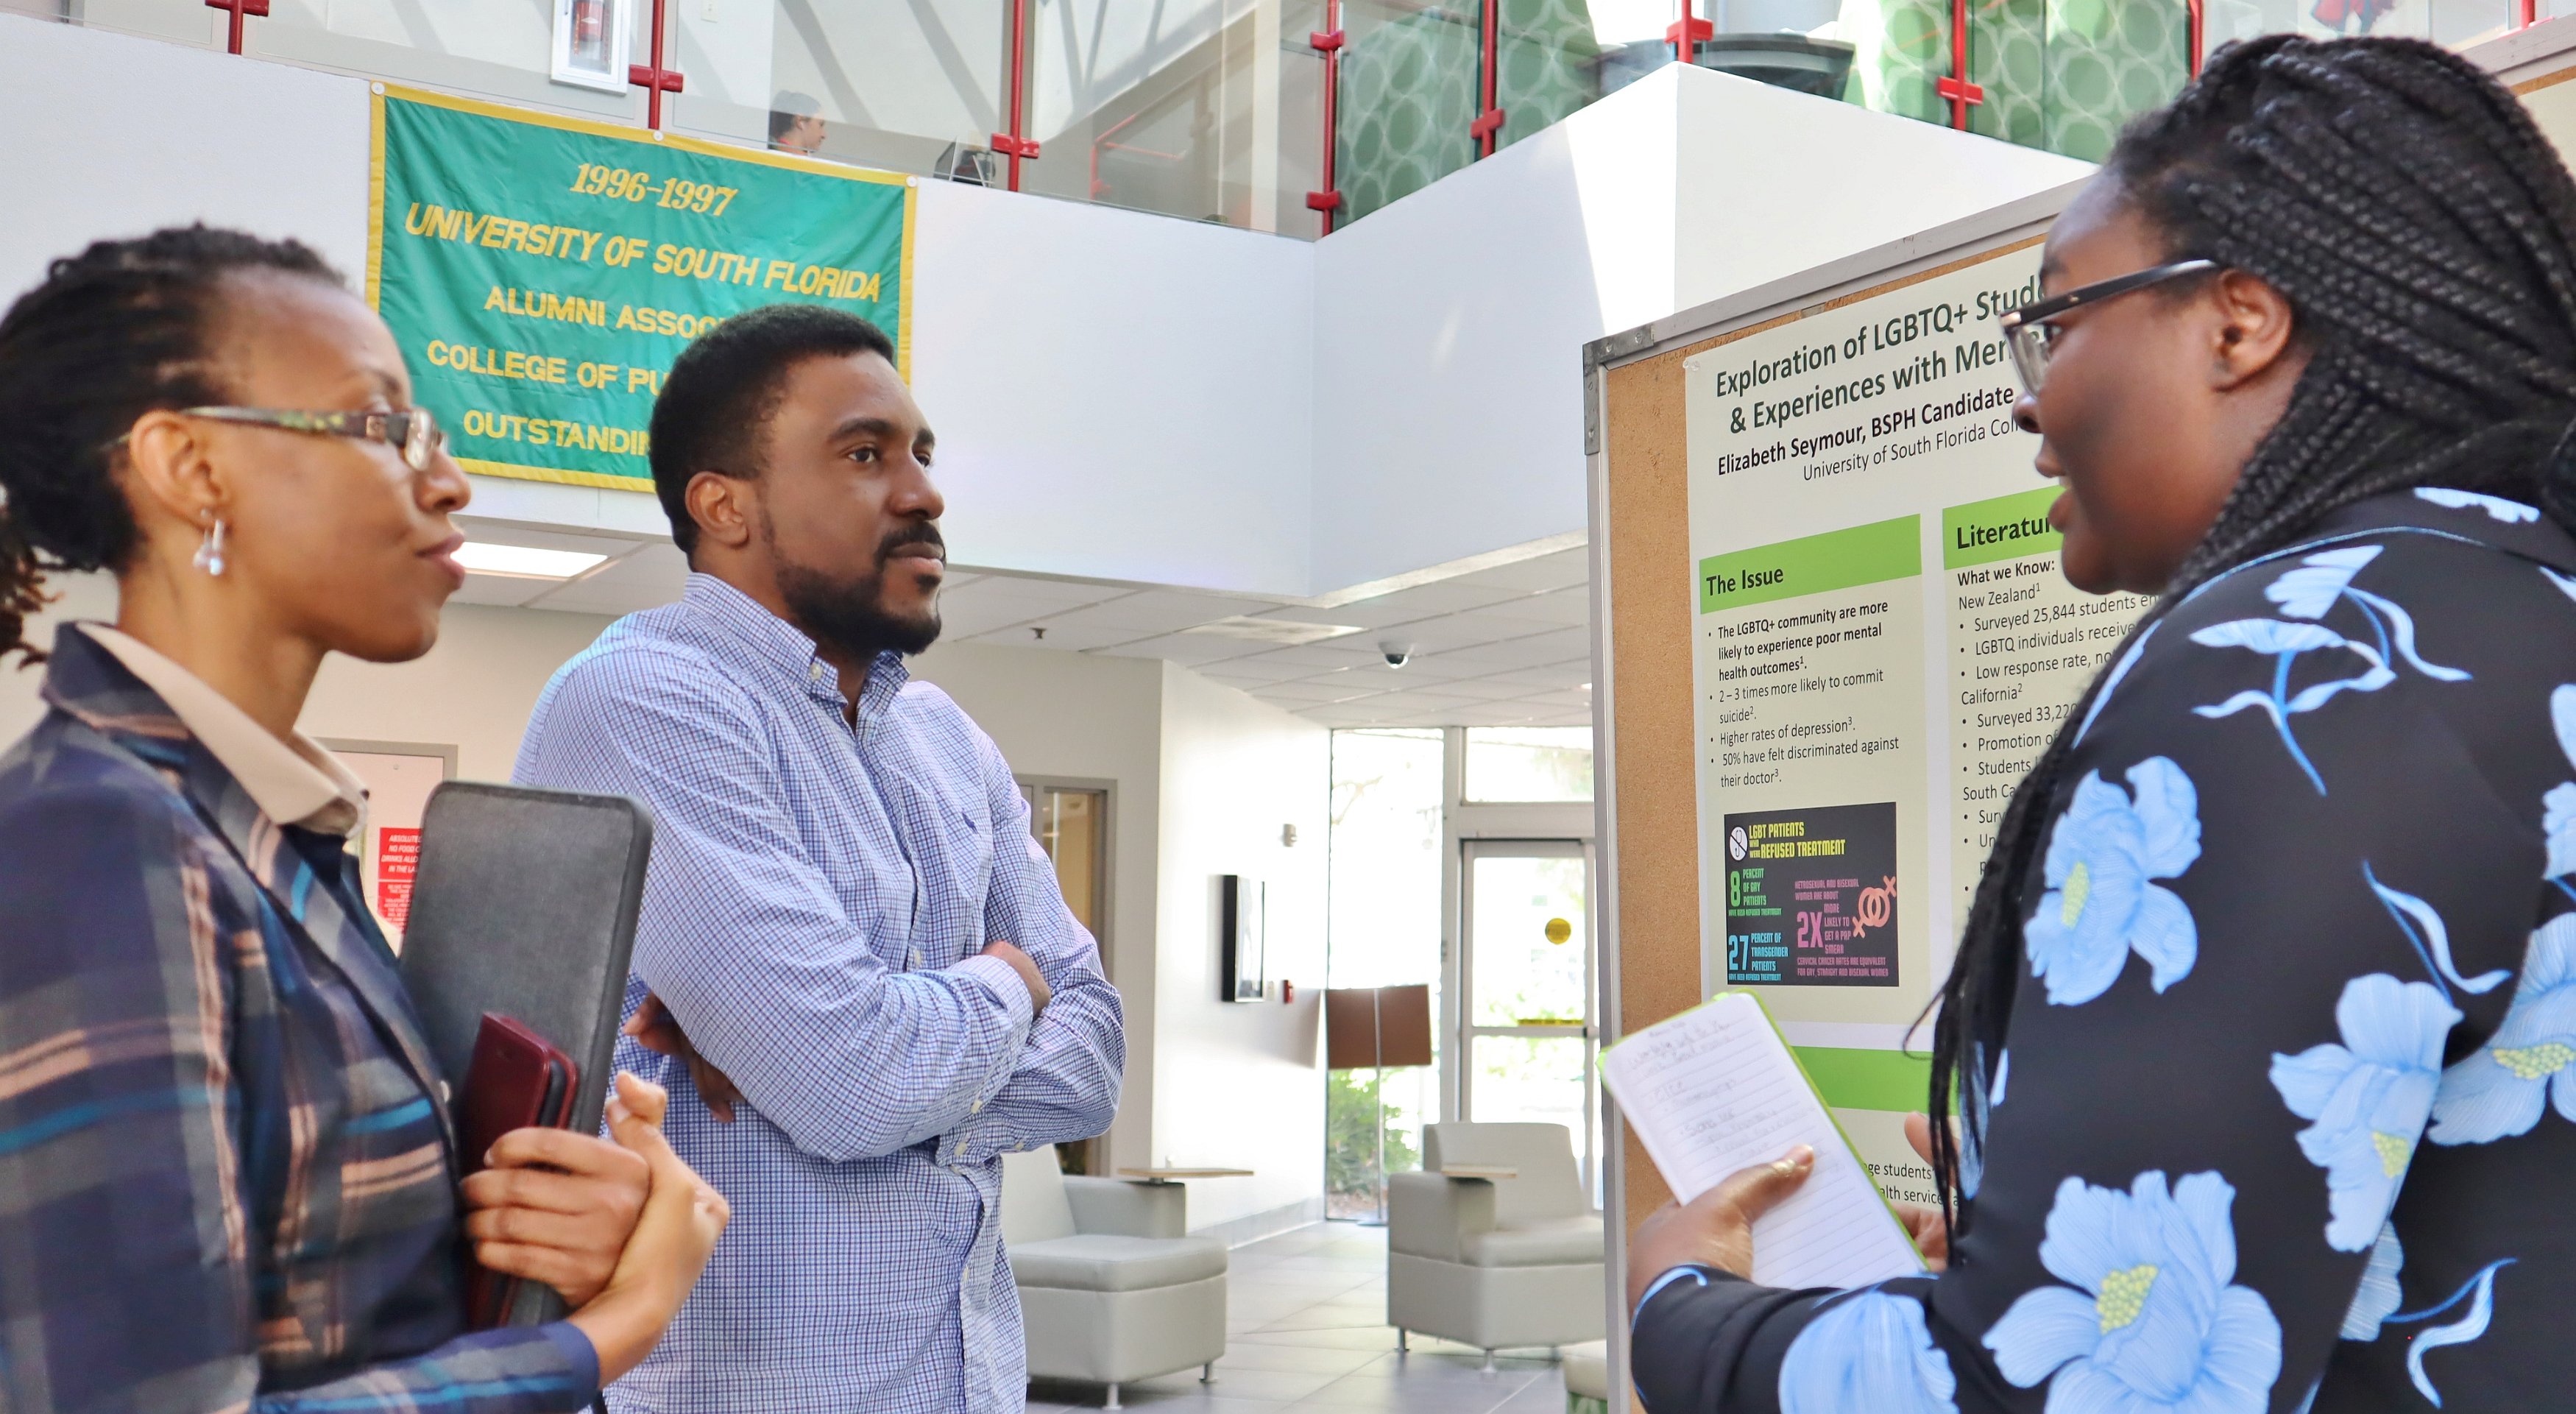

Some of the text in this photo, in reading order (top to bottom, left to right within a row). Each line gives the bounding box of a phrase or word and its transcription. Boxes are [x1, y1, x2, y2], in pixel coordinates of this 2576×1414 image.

[570, 163, 738, 216] 1996-1997
[406, 202, 881, 303] UNIVERSITY OF SOUTH FLORIDA
[484, 286, 721, 339] ALUMNI ASSOC
[1716, 344, 1836, 397] Exploration
[1844, 325, 1867, 359] of
[1875, 303, 1968, 351] LGBTQ+
[427, 339, 670, 397] COLLEGE OF PU
[1730, 338, 2012, 434] & Experiences with Men
[463, 410, 650, 457] OUTSTANDIN
[1719, 387, 2014, 476] Elizabeth Seymour, BSPH Candidate
[1803, 453, 1869, 481] University
[1873, 445, 1887, 464] of
[1891, 435, 1931, 461] South
[1936, 423, 1986, 450] Florida
[1957, 517, 2050, 549] Literatur
[1706, 568, 1784, 596] The Issue
[1958, 559, 2055, 587] What we Know:
[1958, 595, 1984, 610] New
[1975, 609, 2029, 632] Surveyed
[2034, 603, 2076, 623] 25,844
[2079, 597, 2136, 616] students
[1718, 601, 1888, 639] The LGBTQ+ community are more
[1719, 622, 1882, 660] likely to experience poor mental
[1975, 621, 2136, 656] LGBTQ individuals receive
[1719, 665, 1747, 682] health
[1976, 665, 2000, 679] Low
[2004, 659, 2059, 677] response
[2063, 654, 2091, 669] rate,
[1719, 690, 1724, 702] 2
[1734, 687, 1740, 701] 3
[1743, 686, 1769, 699] times
[1771, 682, 1797, 696] more
[1800, 676, 1826, 693] likely
[1829, 676, 1840, 688] to
[1843, 668, 1883, 686] commit
[1977, 707, 2032, 727] Surveyed
[1720, 730, 1749, 747] Higher
[1752, 729, 1775, 741] rates
[1778, 724, 1788, 738] of
[1978, 733, 2042, 752] Promotion
[1722, 736, 1900, 766] 50% have felt discriminated against
[1721, 774, 1741, 788] their
[1978, 759, 2031, 776] Students
[1963, 785, 1998, 801] South
[1749, 821, 1804, 839] LGBT PATIENTS
[1978, 810, 2006, 824] Surv
[1761, 842, 1795, 858] REFUSED
[1797, 839, 1846, 857] TREATMENT
[1730, 869, 1764, 907] 8 PERCENT
[1743, 882, 1761, 892] OF GAY
[1743, 895, 1766, 905] PATIENTS
[1797, 911, 1850, 948] 2X LIKELY TO
[1825, 931, 1834, 941] GET
[1840, 930, 1852, 940] PAP
[1728, 933, 1781, 970] 27 PERCENT OF
[1752, 947, 1788, 957] TRANSGENDER
[1825, 944, 1844, 954] SMEAR
[1752, 961, 1776, 972] PATIENTS
[1904, 1189, 1943, 1205] service
